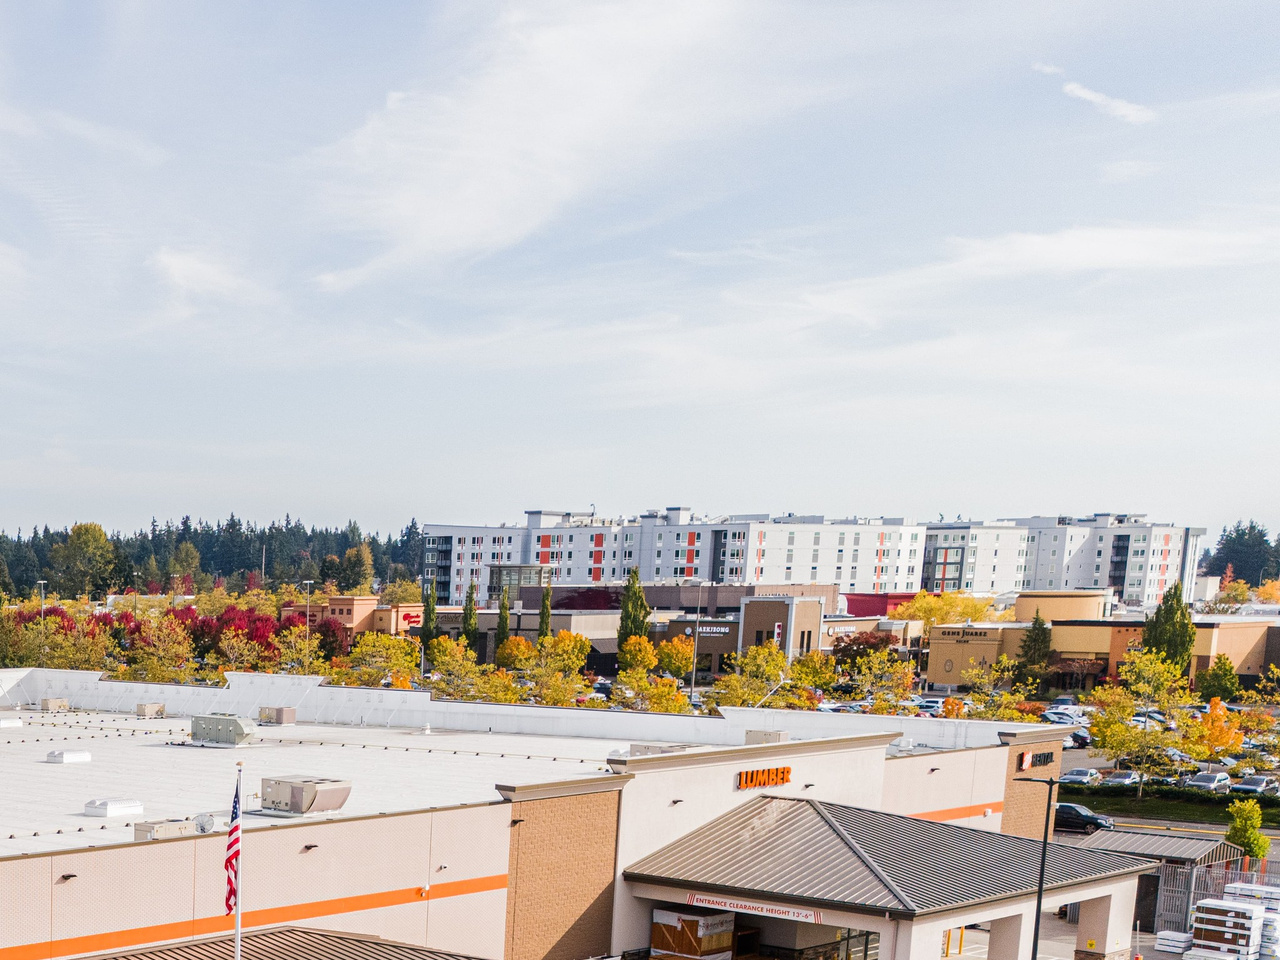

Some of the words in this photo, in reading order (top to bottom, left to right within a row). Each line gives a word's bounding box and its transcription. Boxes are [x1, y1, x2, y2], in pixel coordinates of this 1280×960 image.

[1032, 752, 1054, 767] RENTAL
[739, 766, 791, 790] LUMBER
[695, 897, 727, 907] ENTRANCE
[728, 902, 764, 912] CLEARANCE
[765, 908, 790, 917] HEIGHT
